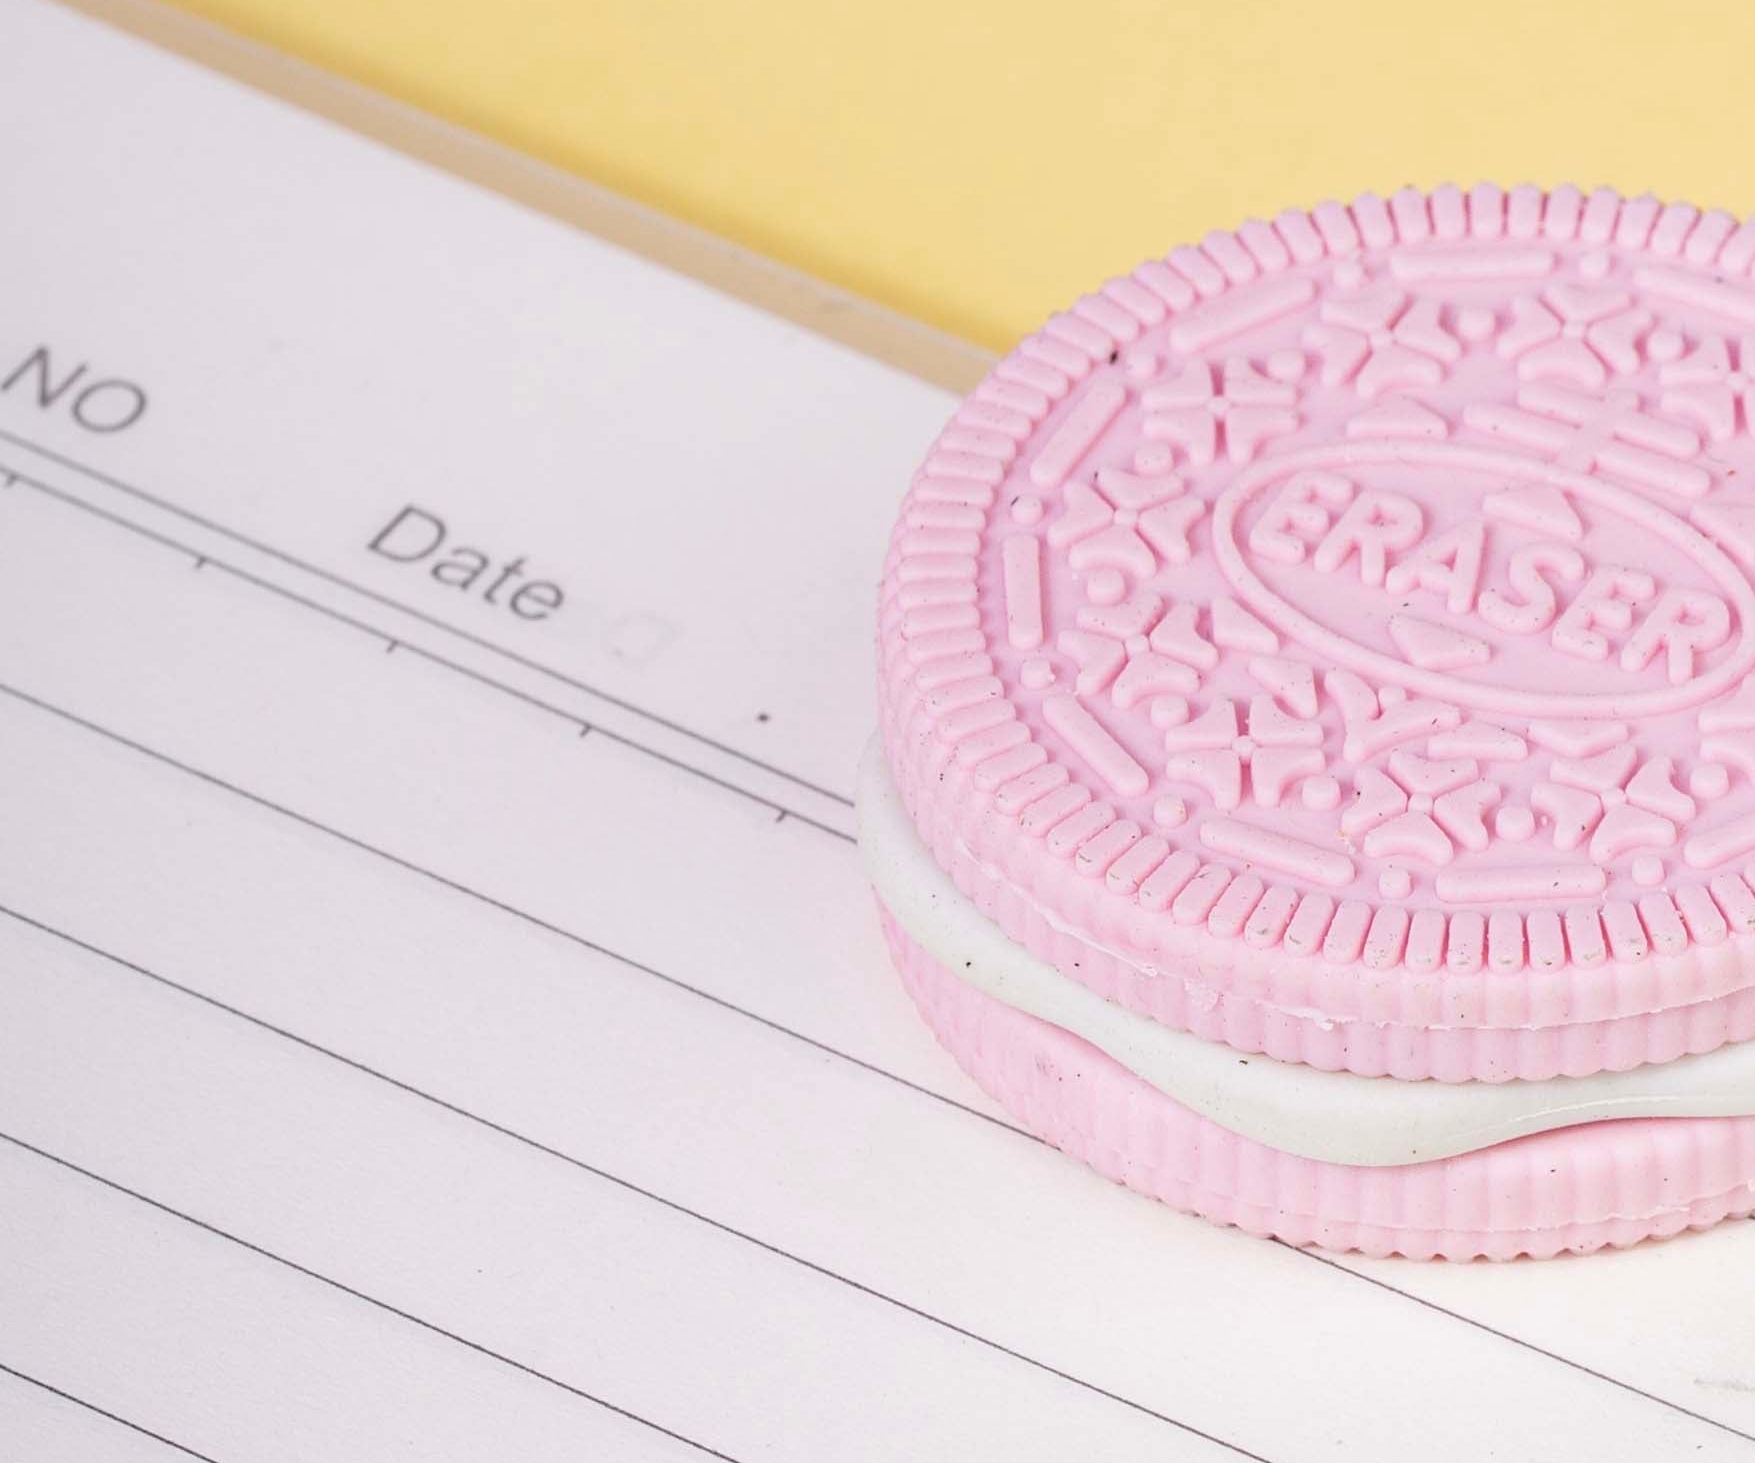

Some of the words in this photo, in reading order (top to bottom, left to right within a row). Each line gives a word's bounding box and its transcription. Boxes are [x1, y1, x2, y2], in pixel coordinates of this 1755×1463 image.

[0, 346, 147, 433] NO
[366, 505, 565, 621] Date
[1249, 472, 1731, 685] ERASER
